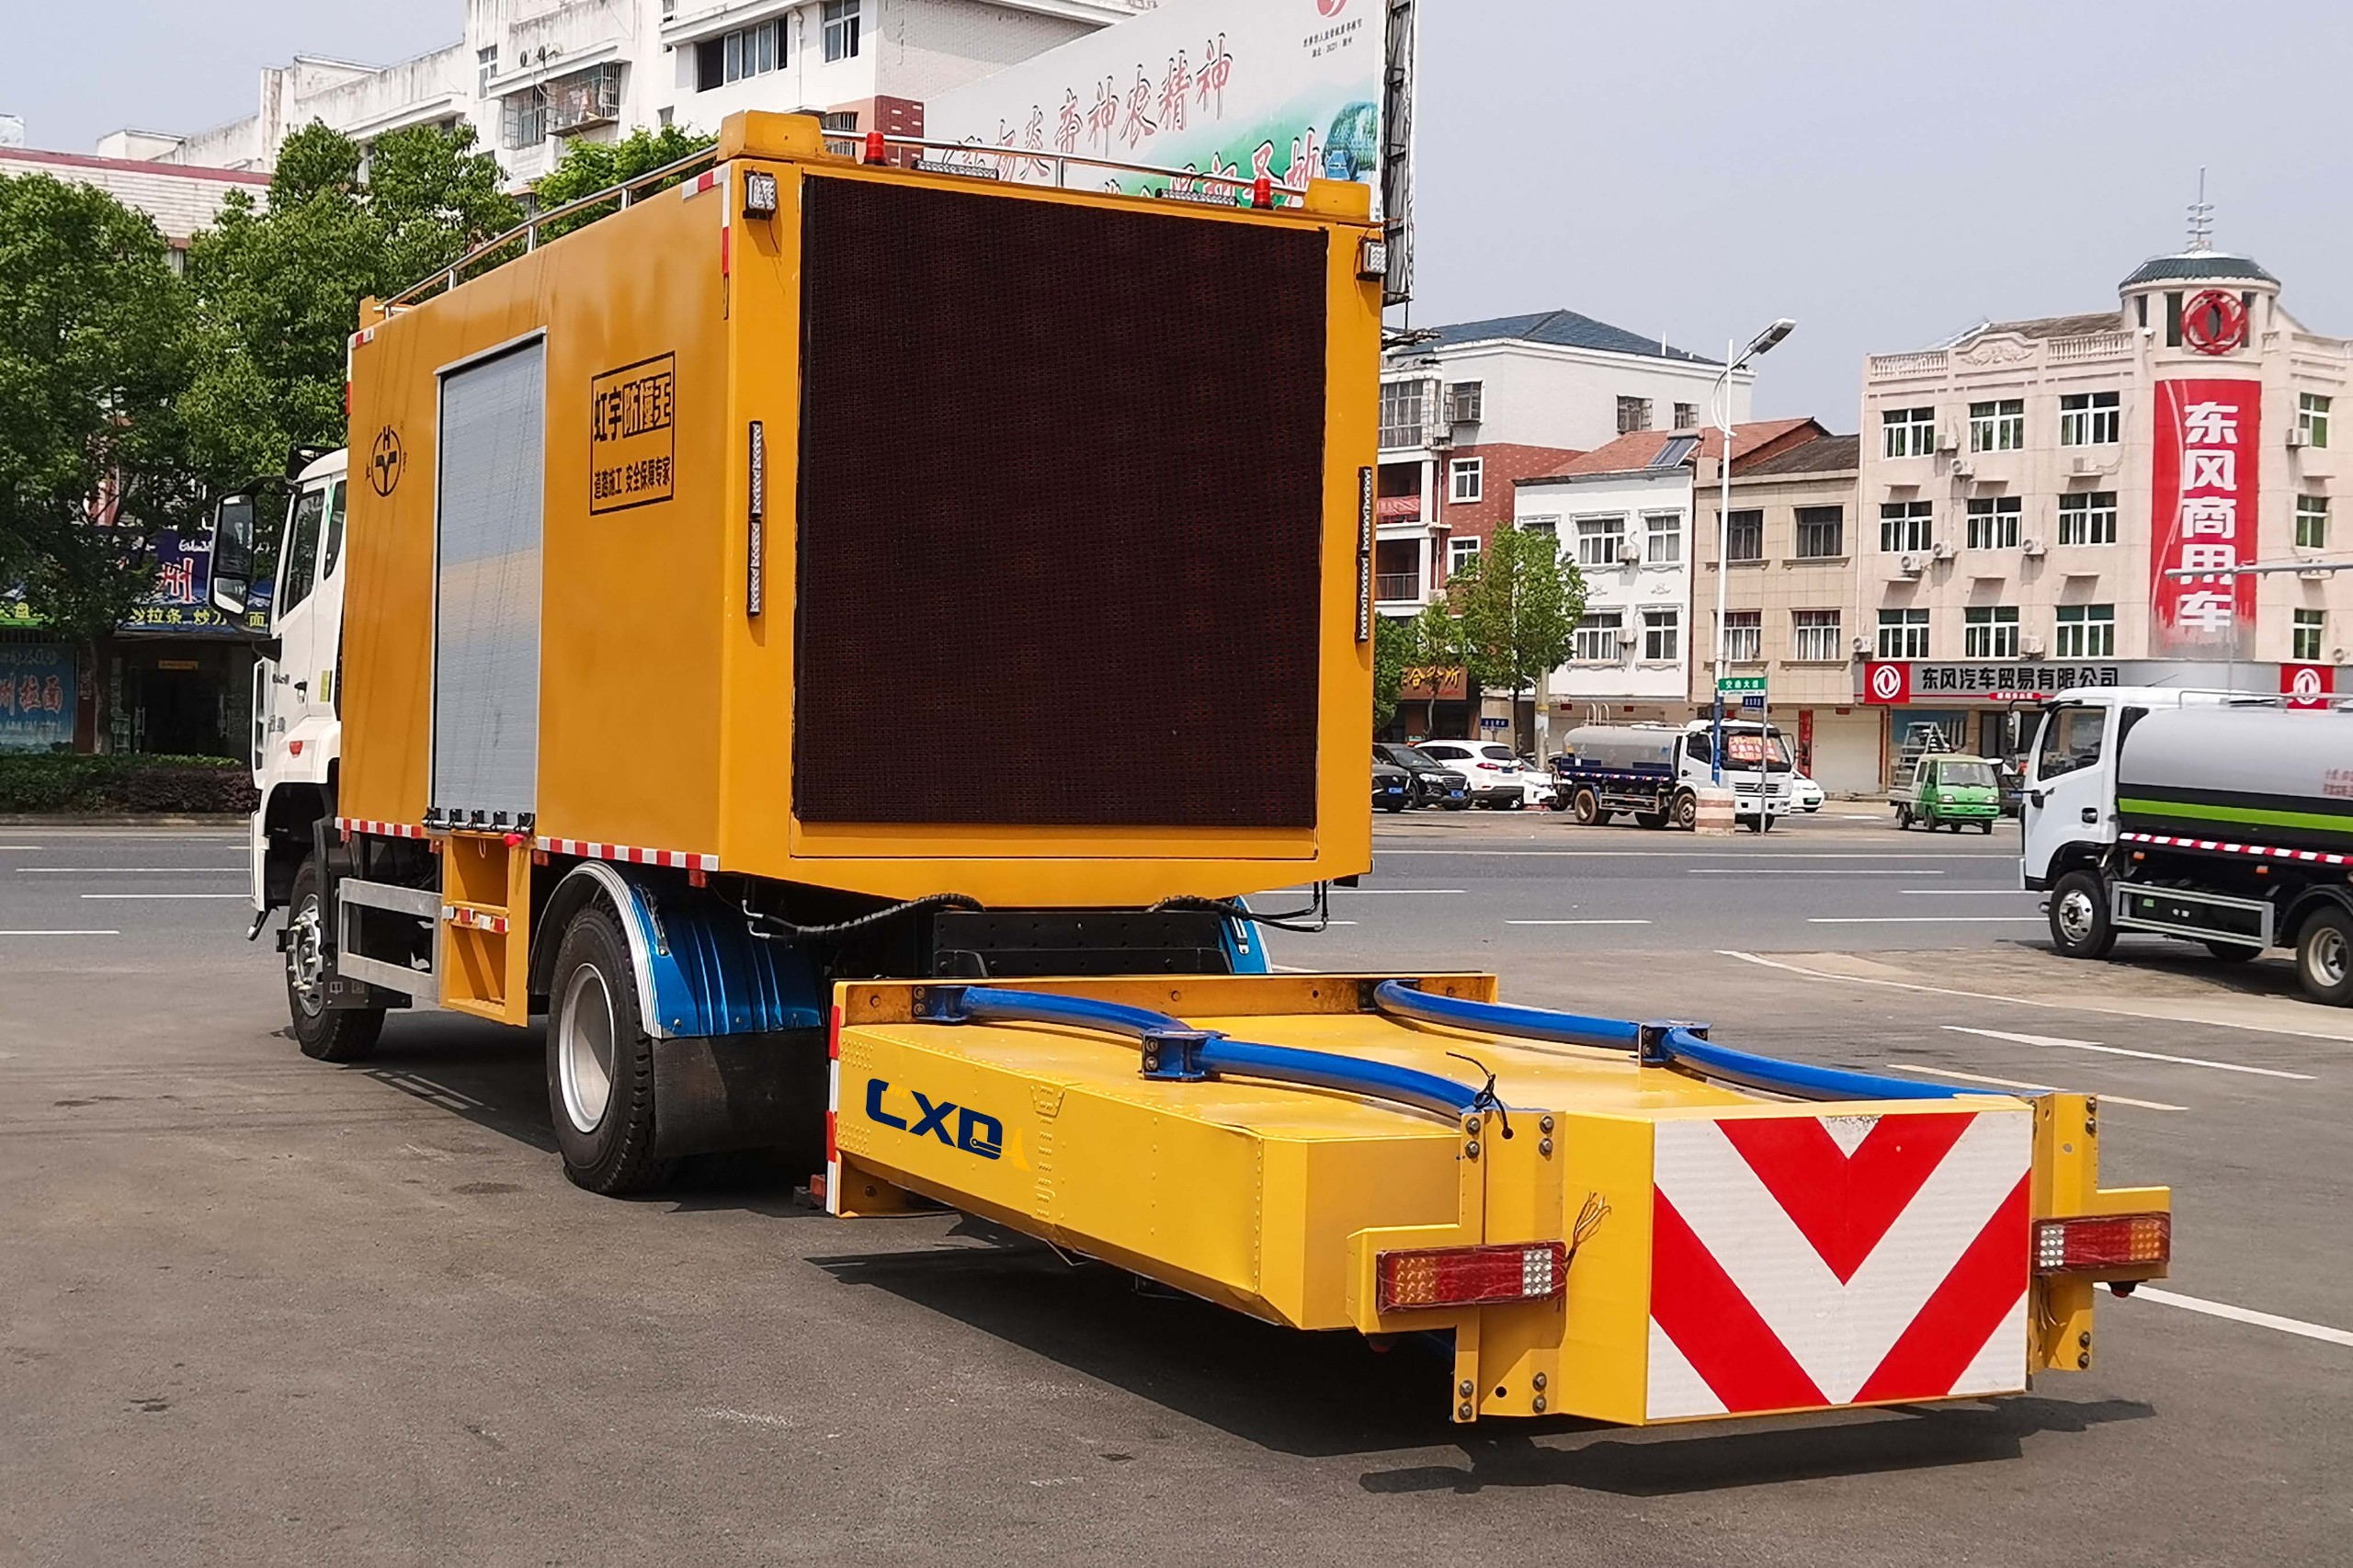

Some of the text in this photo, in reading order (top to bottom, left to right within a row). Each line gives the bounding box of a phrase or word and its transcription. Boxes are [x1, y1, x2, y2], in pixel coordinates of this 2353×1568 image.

[625, 455, 671, 494] 安全保障专家
[2178, 401, 2238, 633] 东风商用车
[1922, 666, 2119, 690] 东风汽车贸易有限公司
